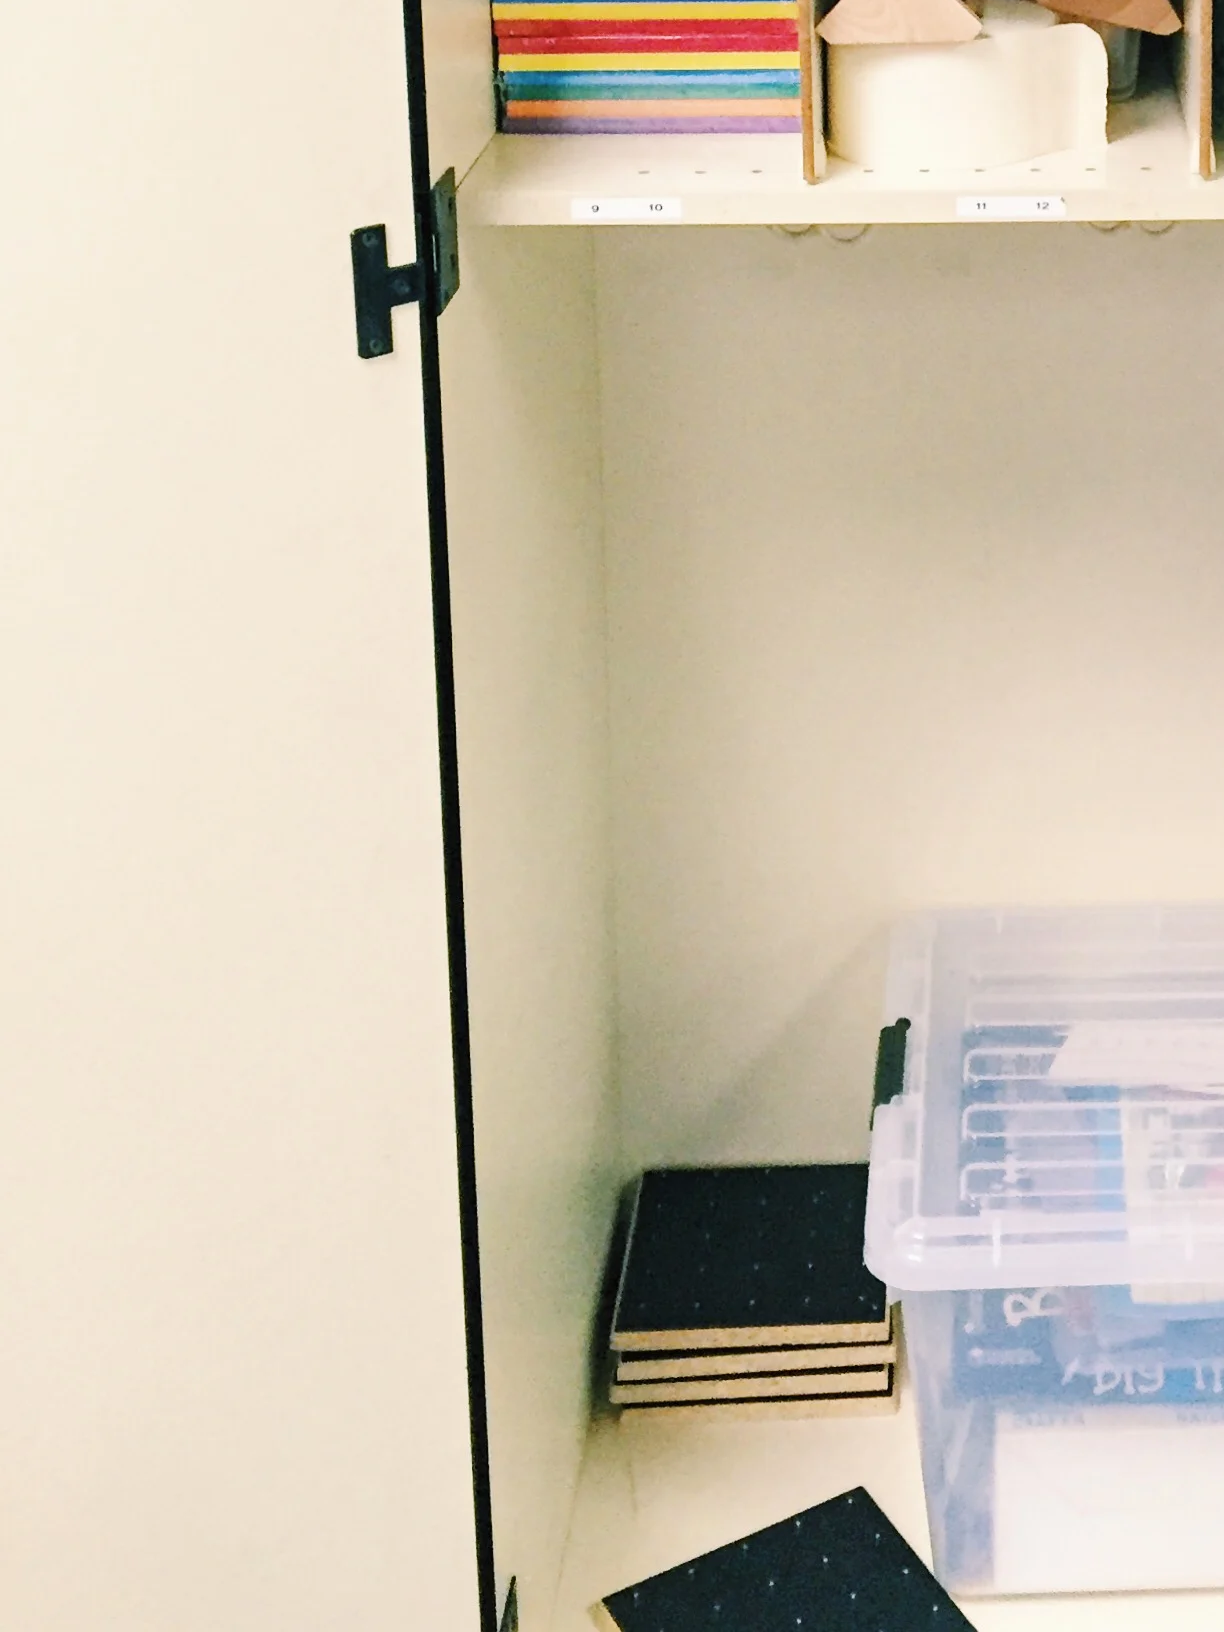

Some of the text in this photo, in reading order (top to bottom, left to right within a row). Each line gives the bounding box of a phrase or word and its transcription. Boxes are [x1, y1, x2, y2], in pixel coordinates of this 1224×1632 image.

[591, 203, 663, 213] 9 10
[976, 201, 1050, 211] 11 12
